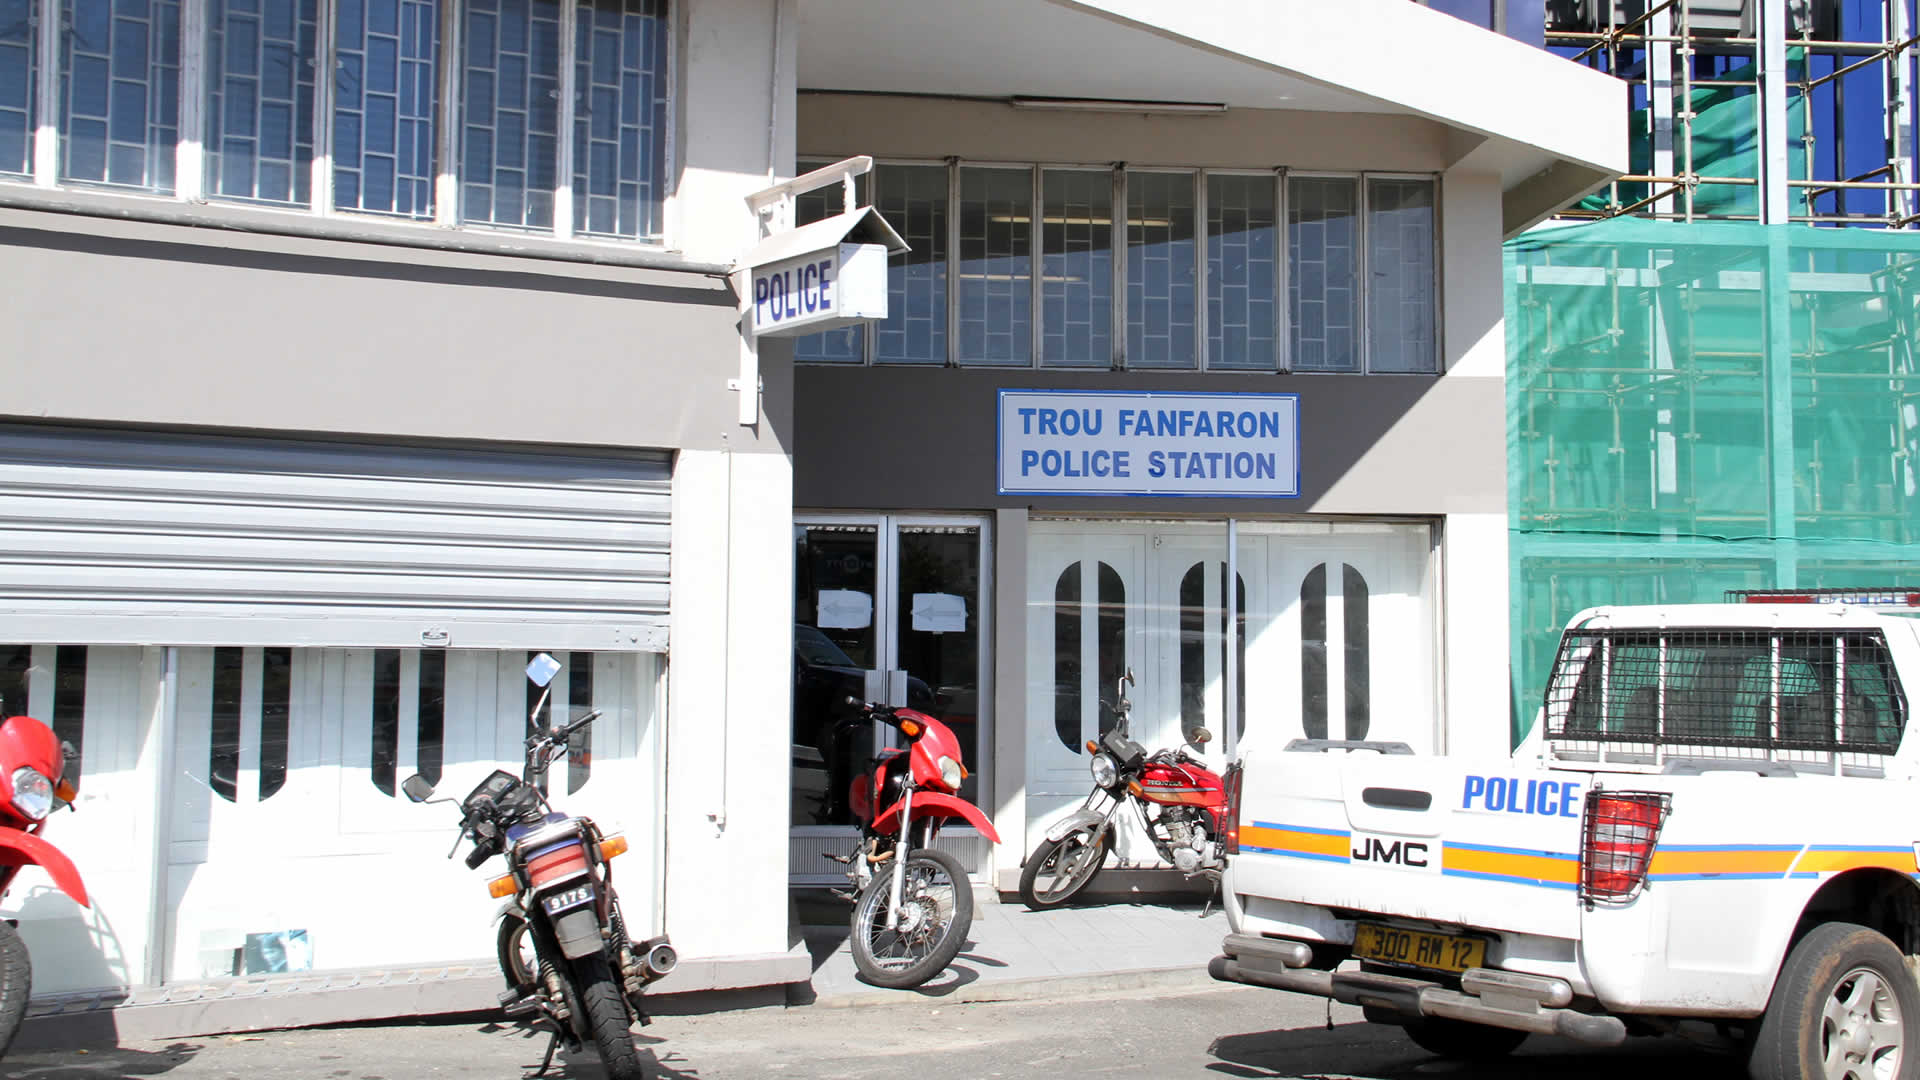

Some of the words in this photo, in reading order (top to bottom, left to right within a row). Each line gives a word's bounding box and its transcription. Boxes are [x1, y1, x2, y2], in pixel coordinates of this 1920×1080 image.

[756, 260, 831, 325] POLICE
[1018, 408, 1102, 436] TROU
[1118, 409, 1279, 438] FANFARON
[1021, 449, 1130, 478] POLICE
[1147, 451, 1276, 479] STATION
[1462, 775, 1581, 818] POLICE
[1352, 838, 1428, 867] JMC
[1371, 929, 1410, 960] 300
[1416, 935, 1443, 965] RM
[1451, 941, 1472, 968] 12
